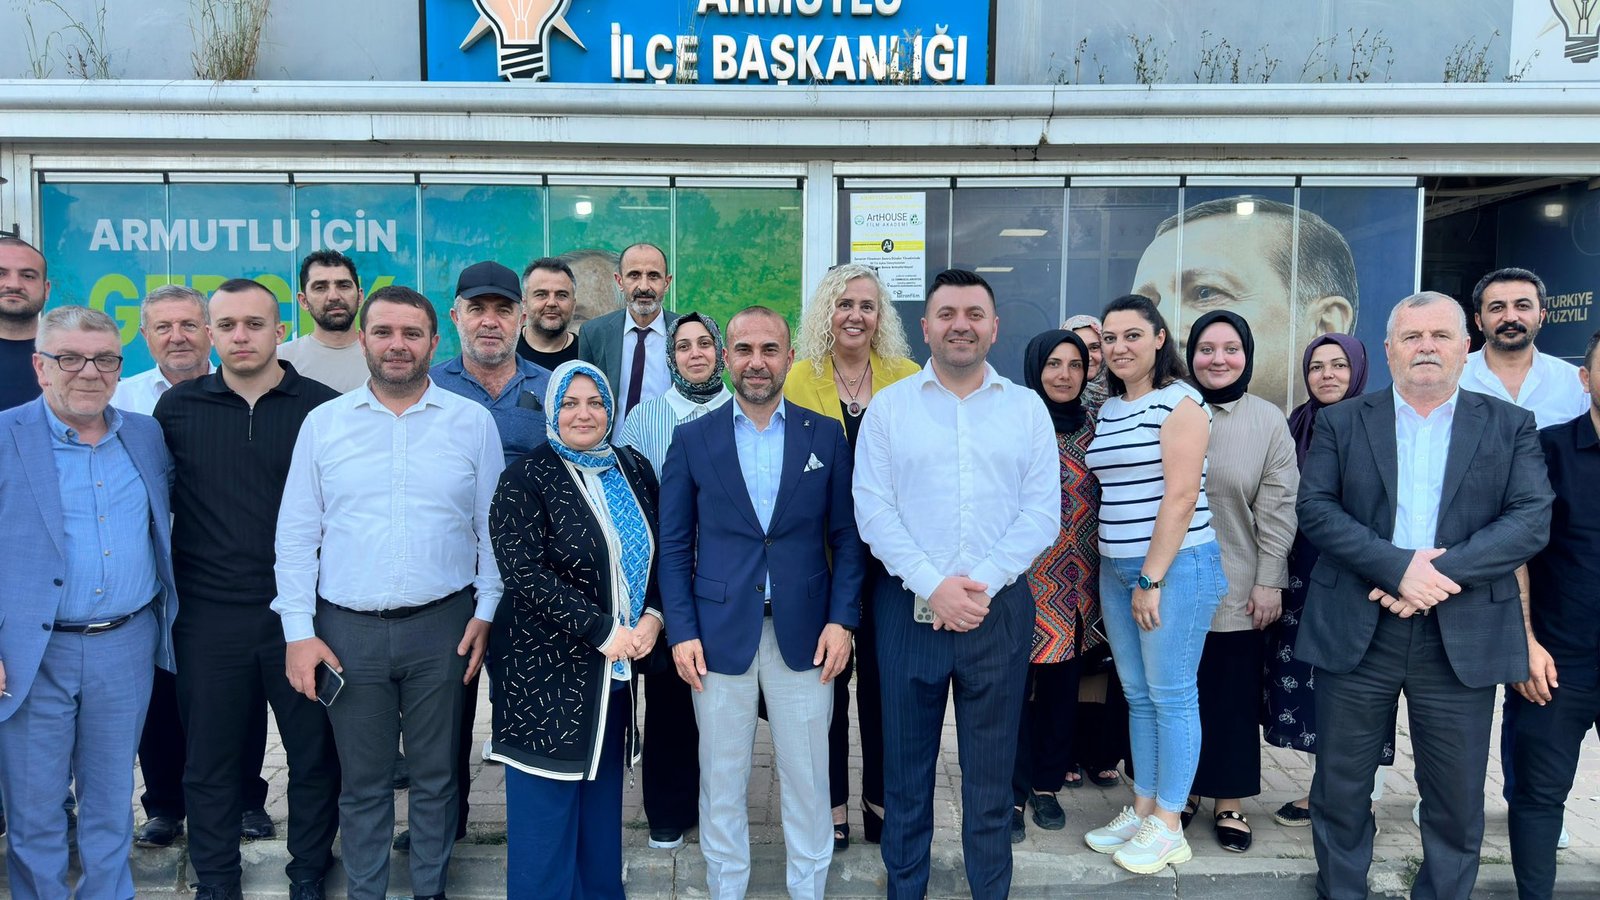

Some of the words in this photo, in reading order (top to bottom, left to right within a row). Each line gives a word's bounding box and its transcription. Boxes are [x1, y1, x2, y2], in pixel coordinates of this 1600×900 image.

[610, 22, 698, 84] İLÇE
[712, 23, 967, 85] BAŞKANLIĞI
[866, 213, 908, 222] ArtHOUSE
[89, 218, 301, 251] ARMUTLU
[1546, 292, 1593, 308] TÜRKİYE
[1546, 307, 1588, 324] YÜZYILI
